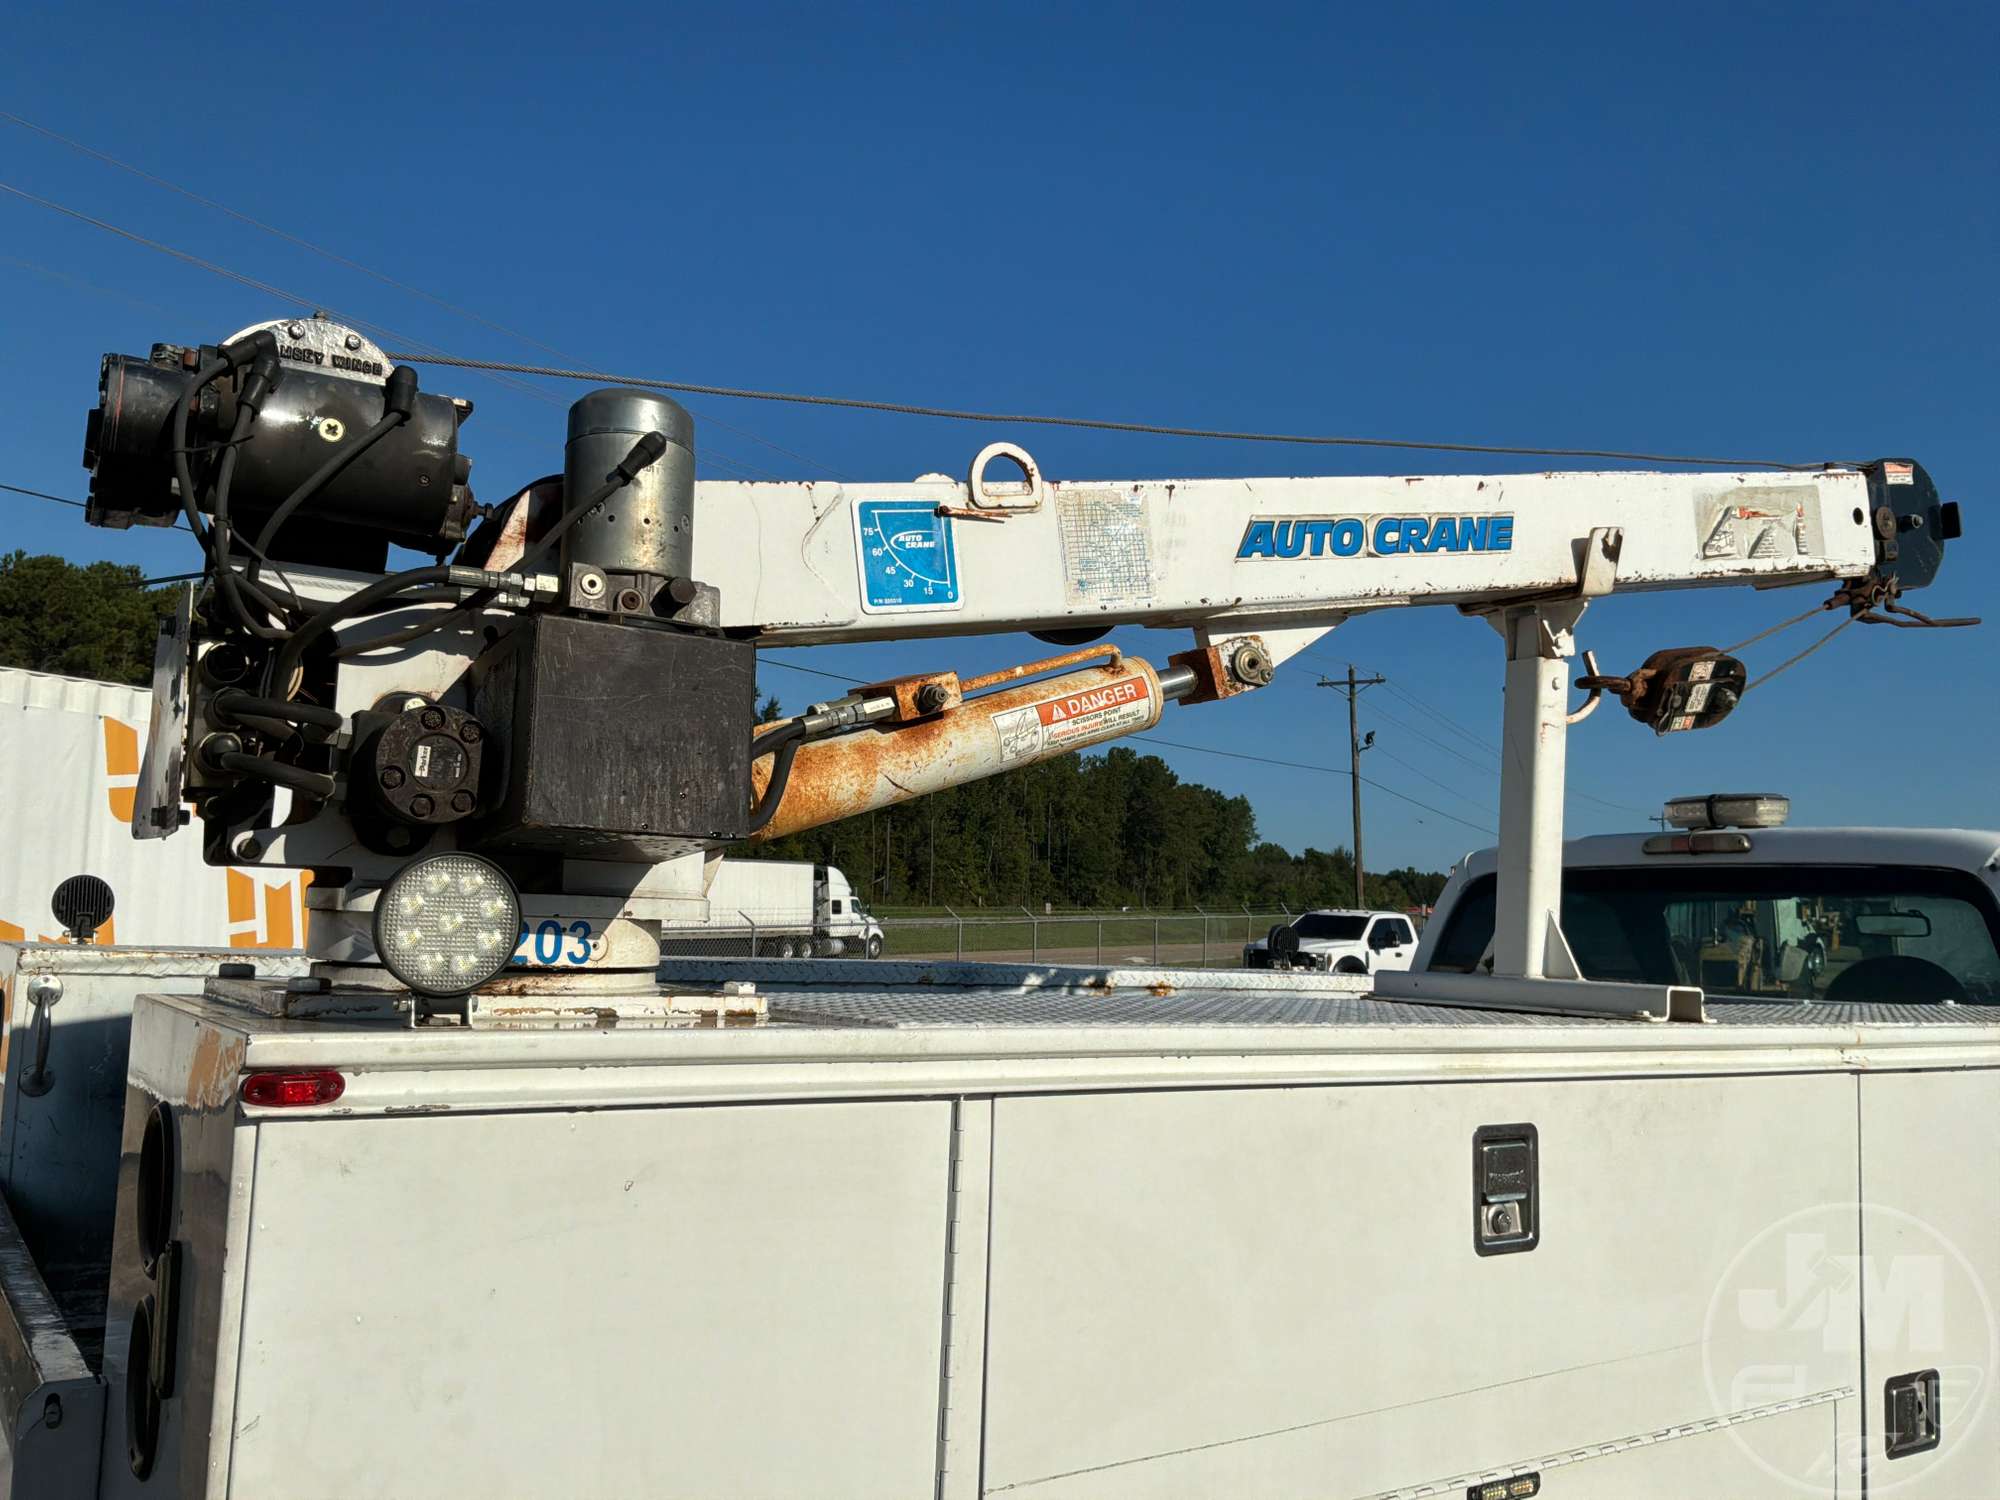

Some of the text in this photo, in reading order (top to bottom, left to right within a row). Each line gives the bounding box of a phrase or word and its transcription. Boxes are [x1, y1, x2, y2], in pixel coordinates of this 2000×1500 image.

[279, 344, 383, 376] MSEY WINCH
[863, 527, 874, 536] 75
[1236, 516, 1514, 559] AUTO CRANE
[872, 548, 883, 556] 60
[885, 566, 896, 575] 45
[903, 579, 914, 588] 30
[923, 587, 934, 595] 15
[947, 591, 954, 599] 0
[1067, 683, 1137, 715] DANGER
[1072, 706, 1121, 726] SCISSORS POINT
[1053, 725, 1080, 739] SERIOUS
[1080, 719, 1104, 731] INJURY
[1117, 709, 1140, 721] RESULT
